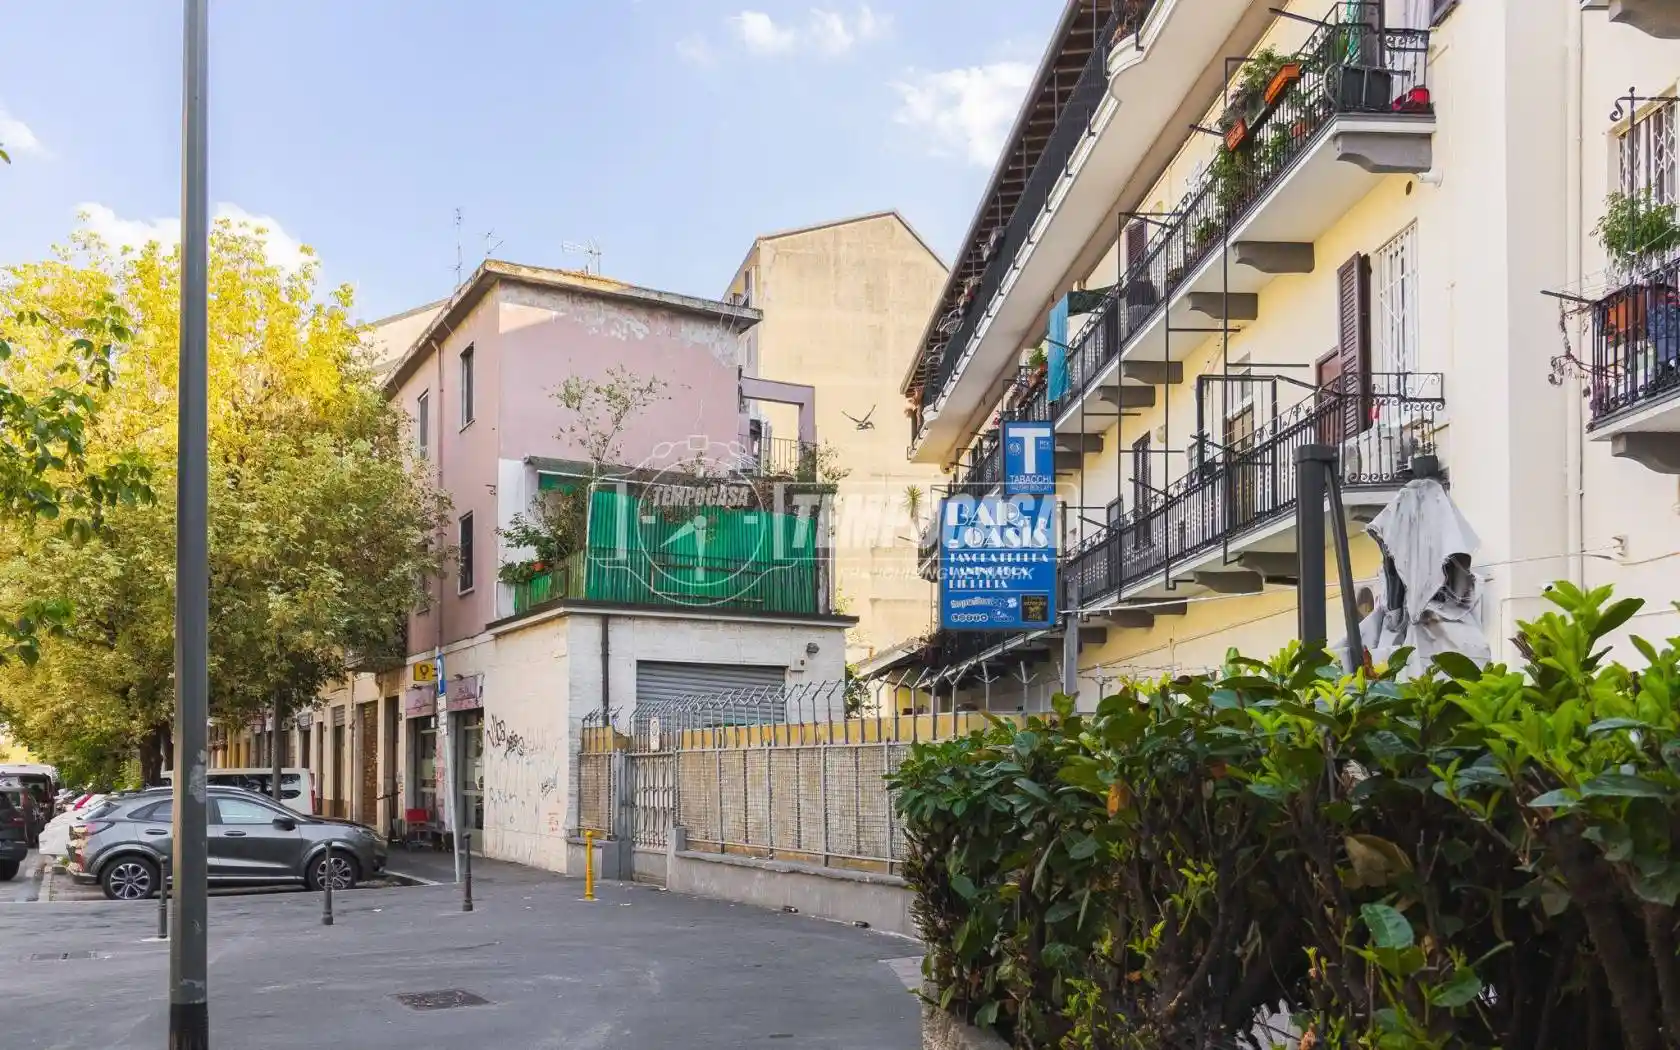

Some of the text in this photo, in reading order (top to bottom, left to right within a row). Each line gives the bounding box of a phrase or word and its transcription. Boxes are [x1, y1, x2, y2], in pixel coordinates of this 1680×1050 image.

[1009, 428, 1050, 473] T
[1009, 475, 1052, 484] TABACCHI
[947, 502, 1023, 526] BAR
